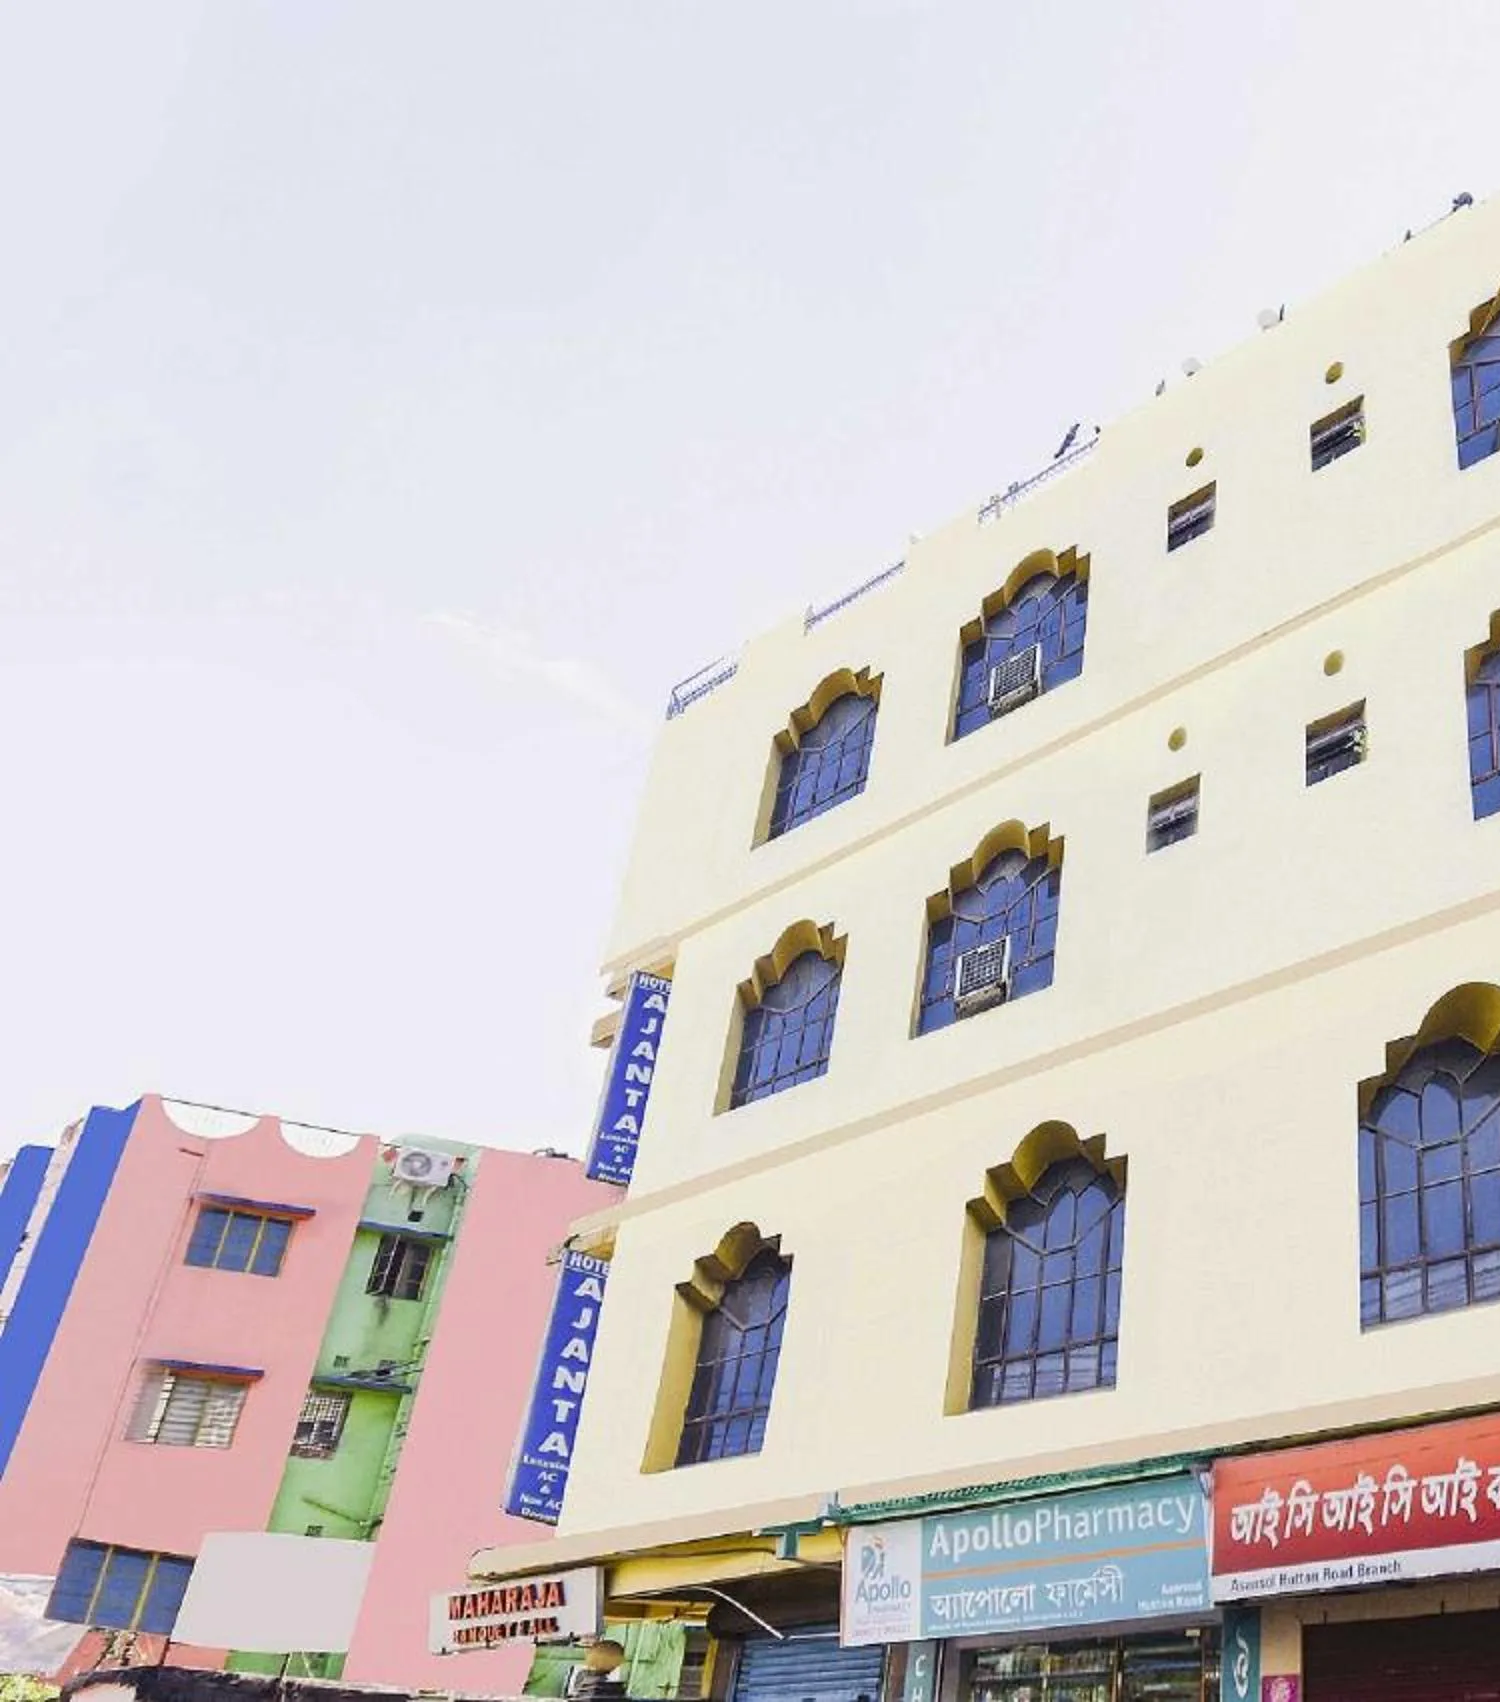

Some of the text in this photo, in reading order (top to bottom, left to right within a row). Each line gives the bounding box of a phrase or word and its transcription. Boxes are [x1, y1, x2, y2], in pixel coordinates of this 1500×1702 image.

[640, 974, 672, 991] HOTE
[613, 993, 666, 1134] AJANTA
[570, 1252, 609, 1275] HOTE
[538, 1277, 602, 1457] AJANTA
[1323, 1565, 1353, 1581] Road
[1357, 1559, 1402, 1577] Branch
[448, 1580, 566, 1620] MAHARAJA
[855, 1574, 911, 1614] Apollo
